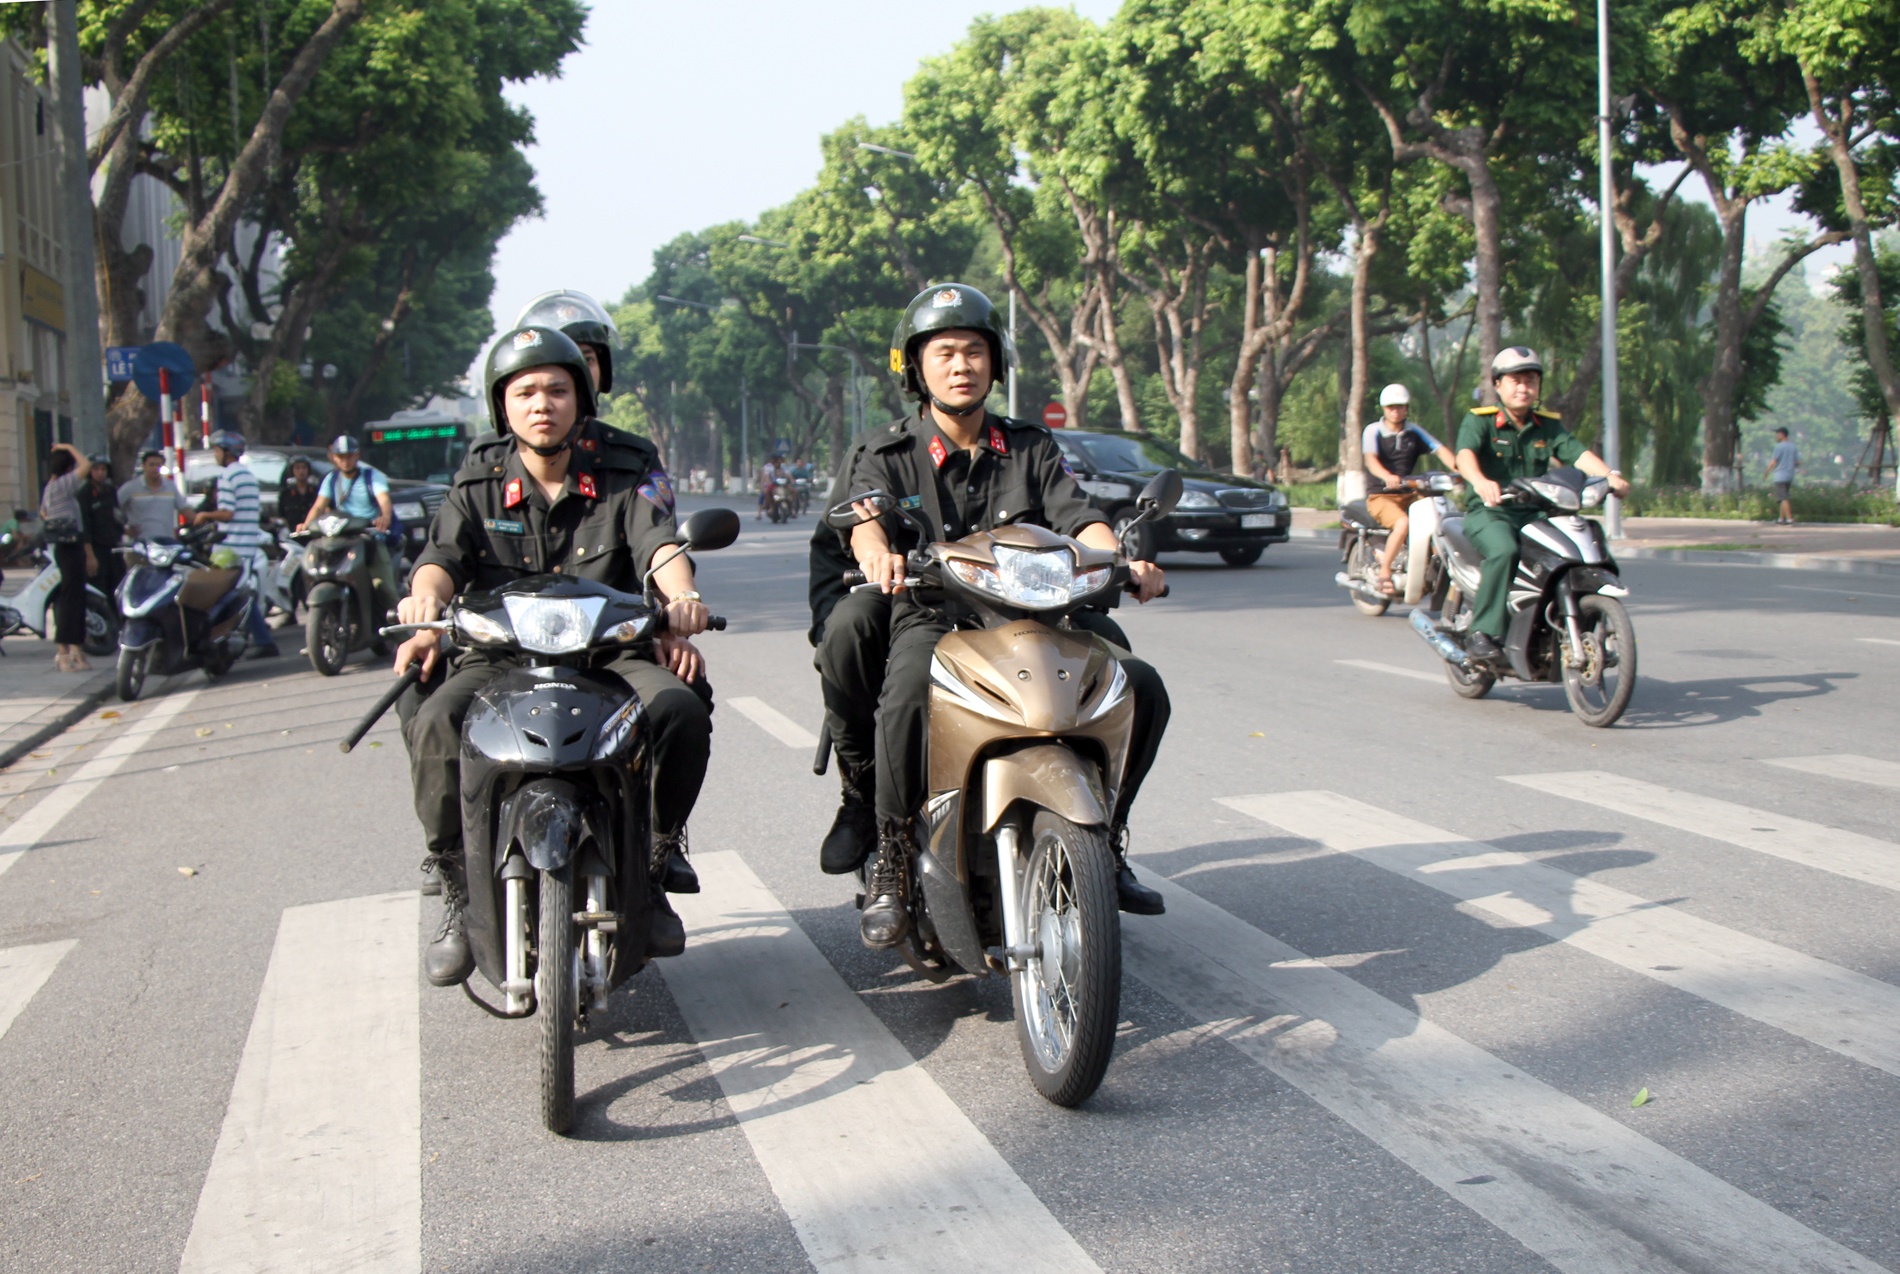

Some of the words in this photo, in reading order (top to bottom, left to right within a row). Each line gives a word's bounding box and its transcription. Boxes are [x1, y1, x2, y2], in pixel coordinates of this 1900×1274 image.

[111, 360, 126, 375] LÊ
[1013, 629, 1052, 637] HONDA
[533, 682, 578, 690] HONDA
